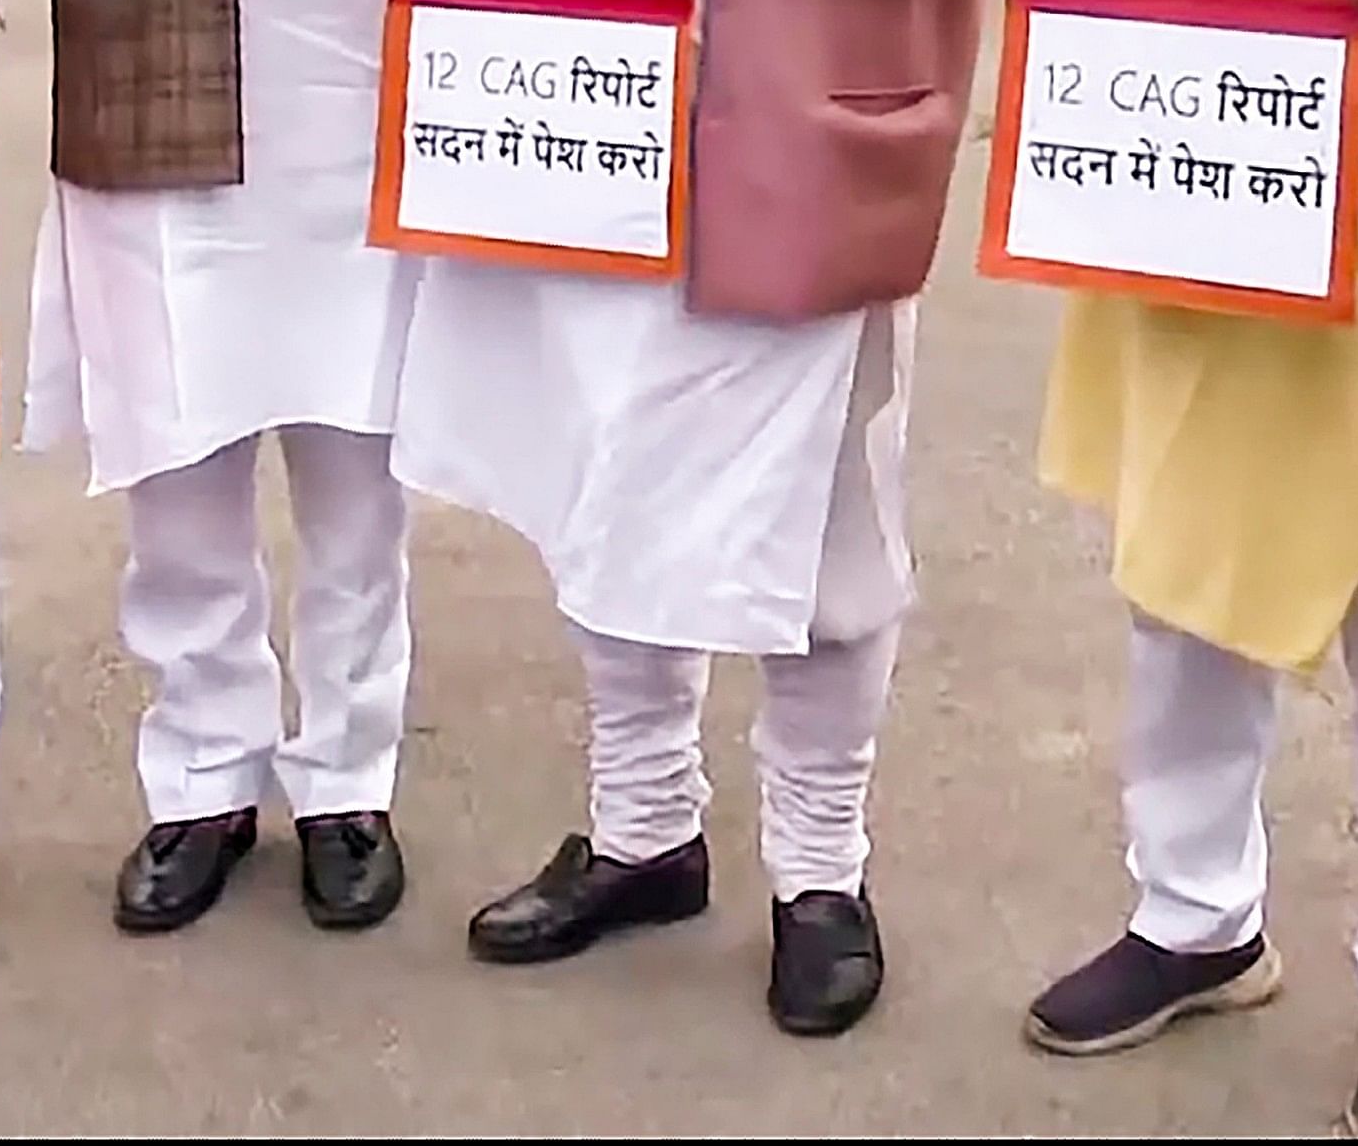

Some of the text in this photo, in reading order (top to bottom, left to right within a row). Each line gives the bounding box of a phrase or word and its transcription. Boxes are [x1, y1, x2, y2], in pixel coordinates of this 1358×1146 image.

[424, 51, 662, 109] 12 CAG रिपोर्ट
[1044, 62, 1326, 131] 12 CAG रिपोर्ट
[411, 116, 665, 181] सदन में पेश करो
[1027, 137, 1328, 209] सदन में पेश करो
